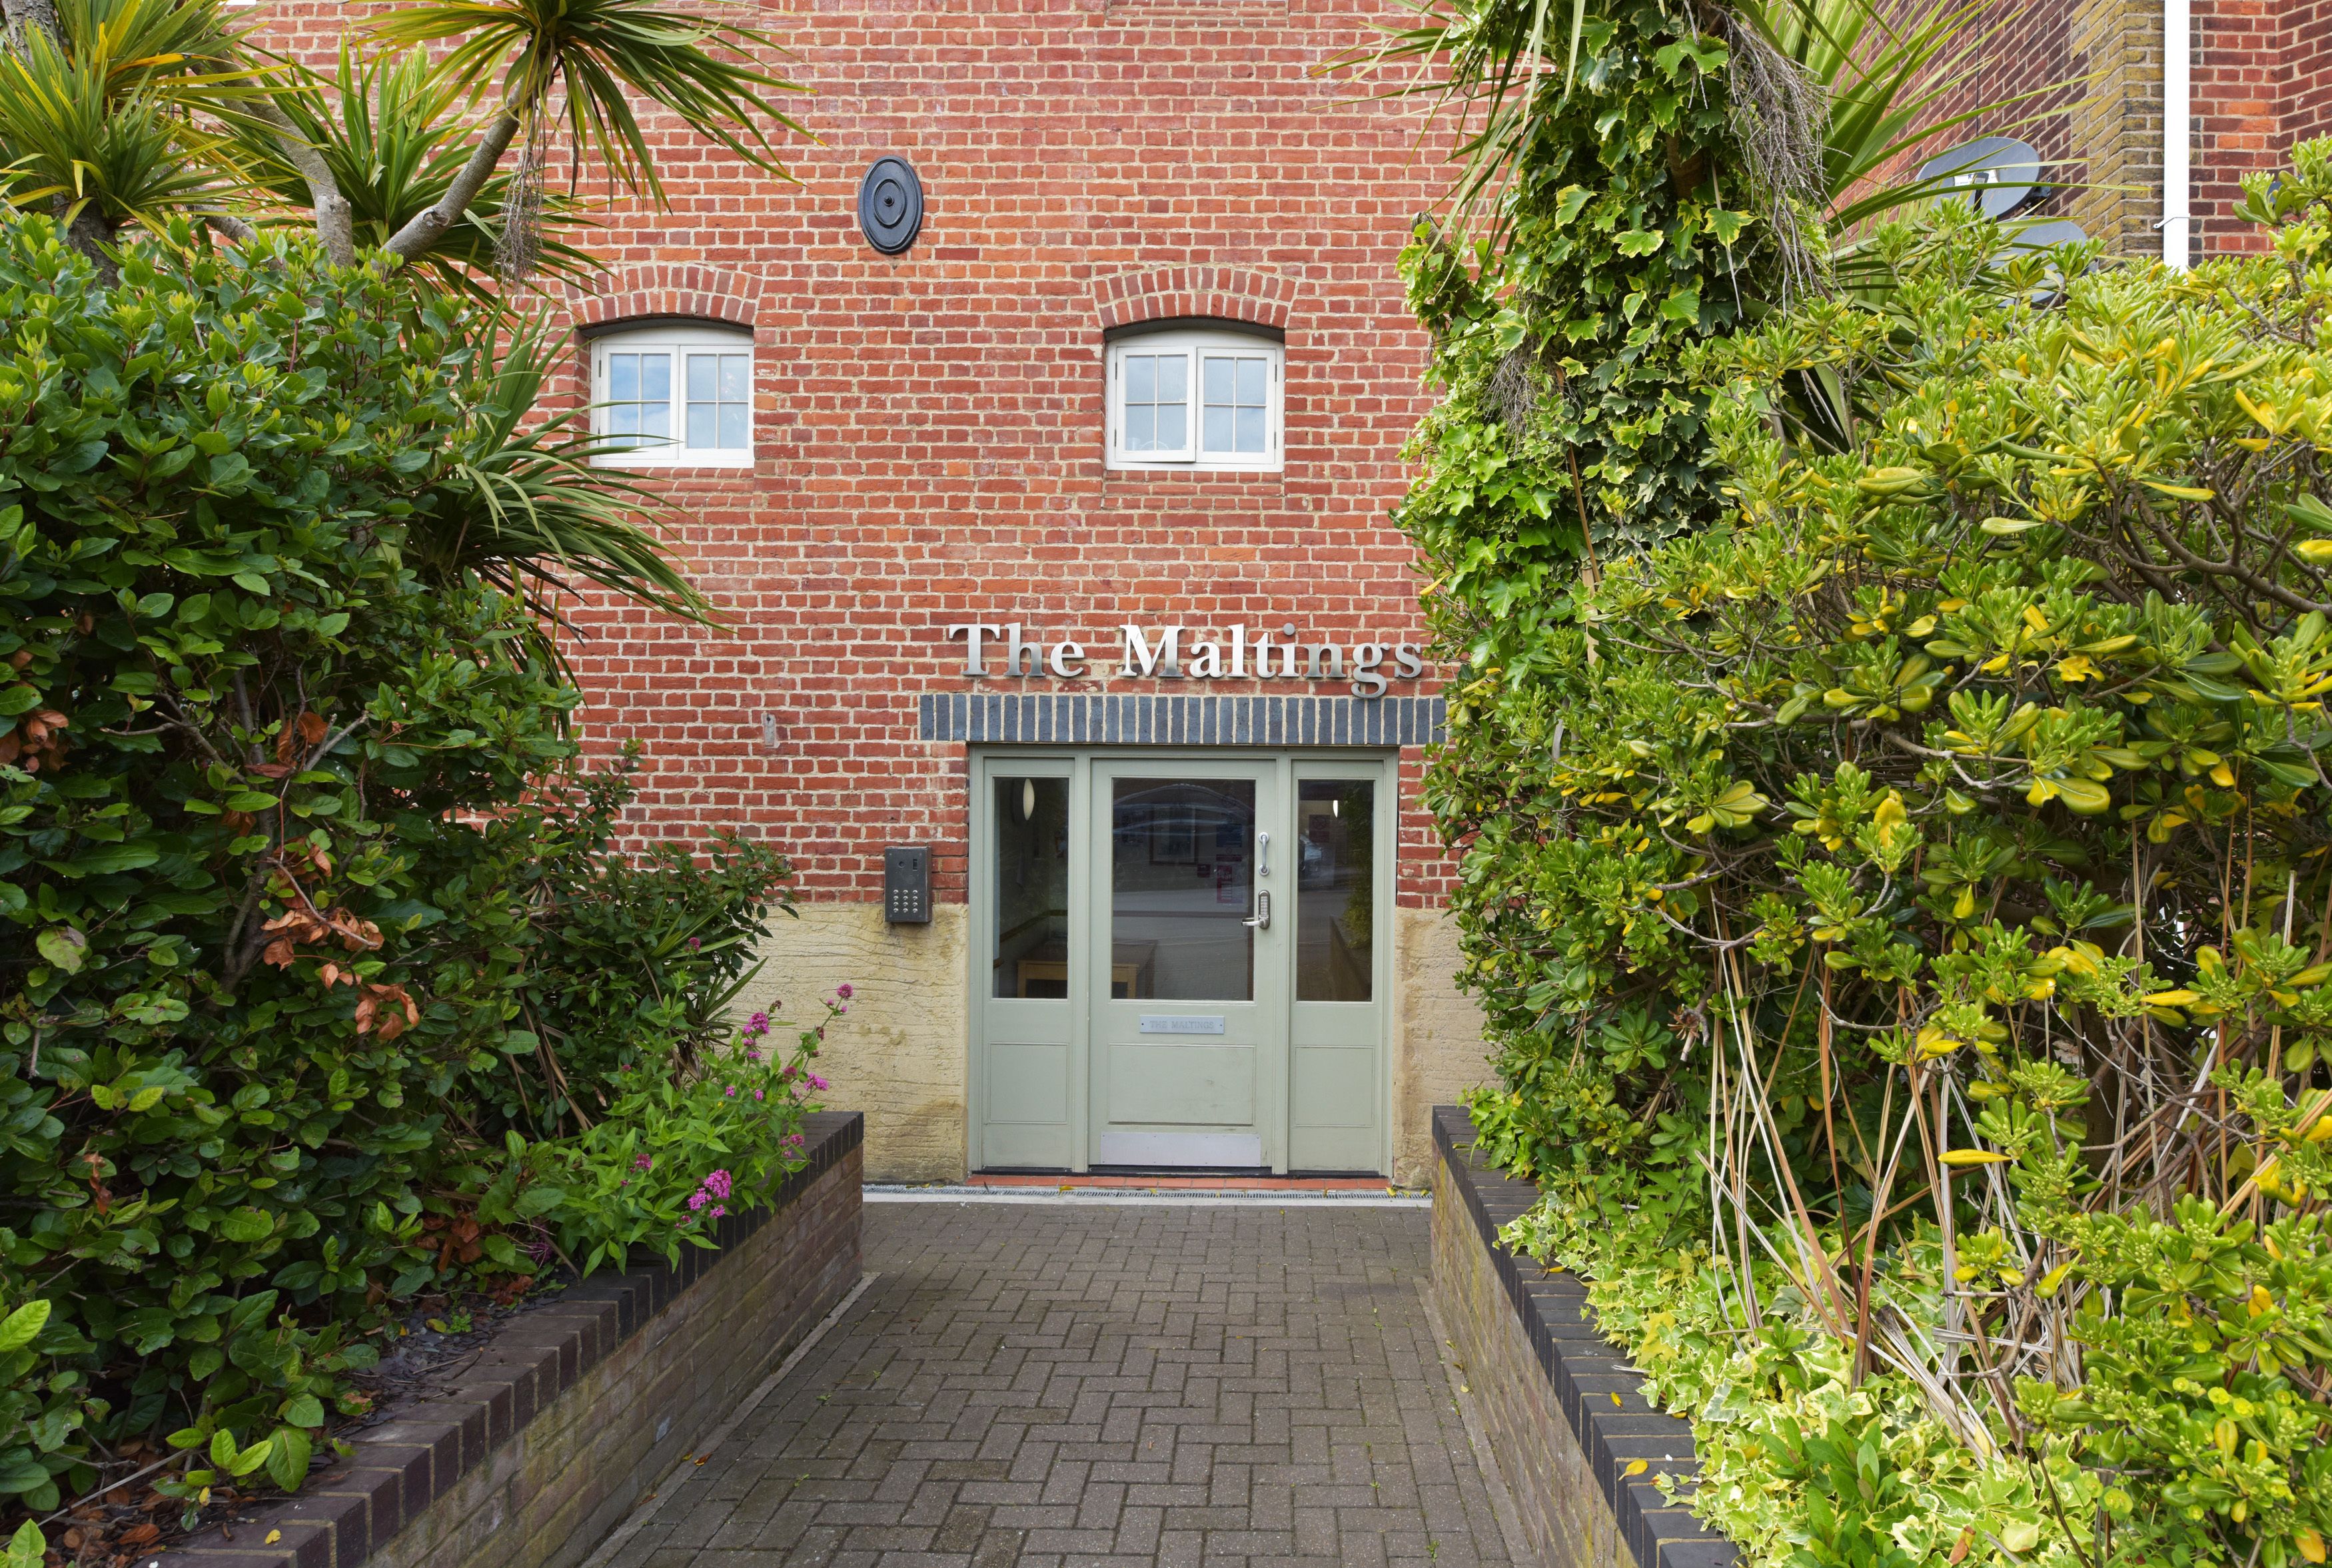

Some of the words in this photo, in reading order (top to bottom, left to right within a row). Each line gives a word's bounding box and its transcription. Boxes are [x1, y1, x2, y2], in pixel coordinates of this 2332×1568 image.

[948, 622, 1085, 678] The
[1119, 622, 1422, 699] Maltings
[1149, 1020, 1168, 1029] THE
[1171, 1020, 1215, 1030] MALTINGS
